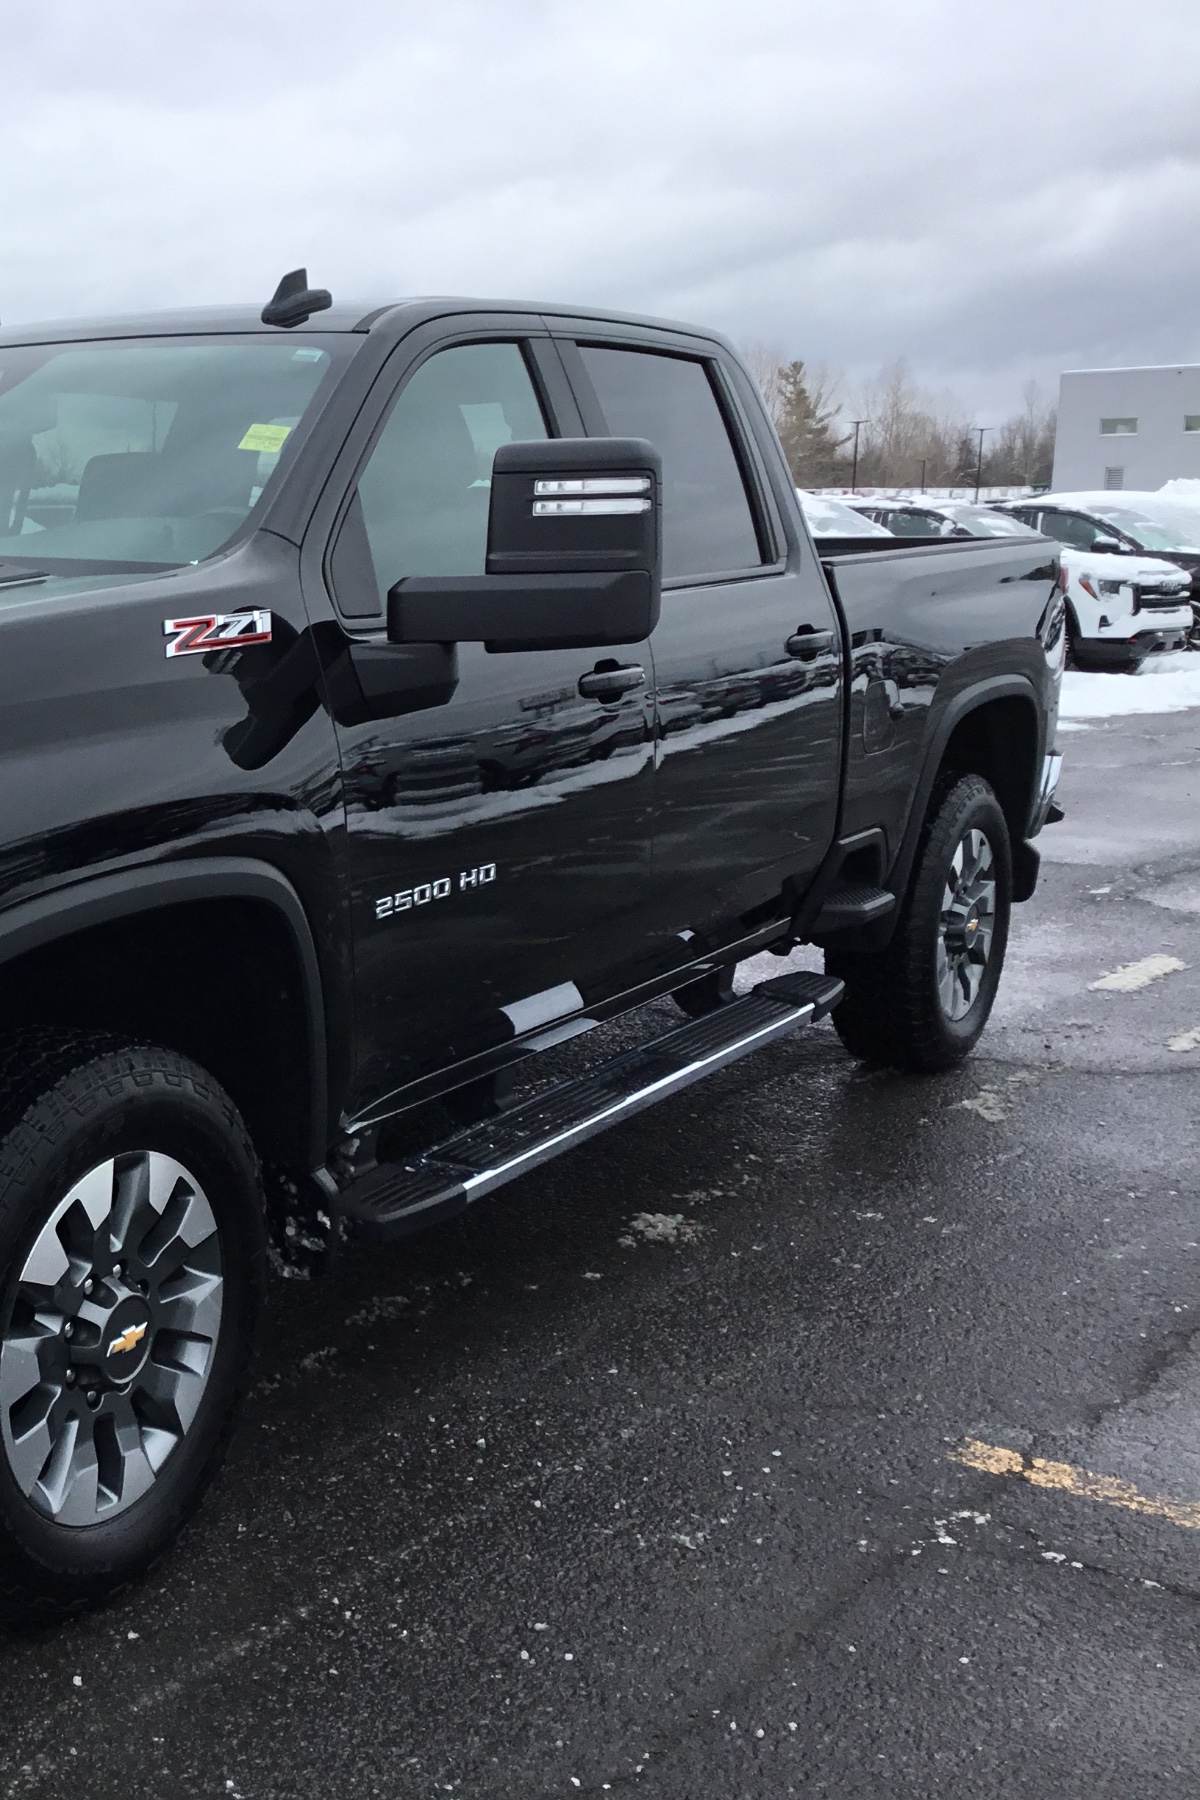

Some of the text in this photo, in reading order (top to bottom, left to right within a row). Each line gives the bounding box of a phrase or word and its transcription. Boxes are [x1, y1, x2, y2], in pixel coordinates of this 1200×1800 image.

[164, 609, 272, 658] Z71
[375, 863, 497, 920] 2500 HD
